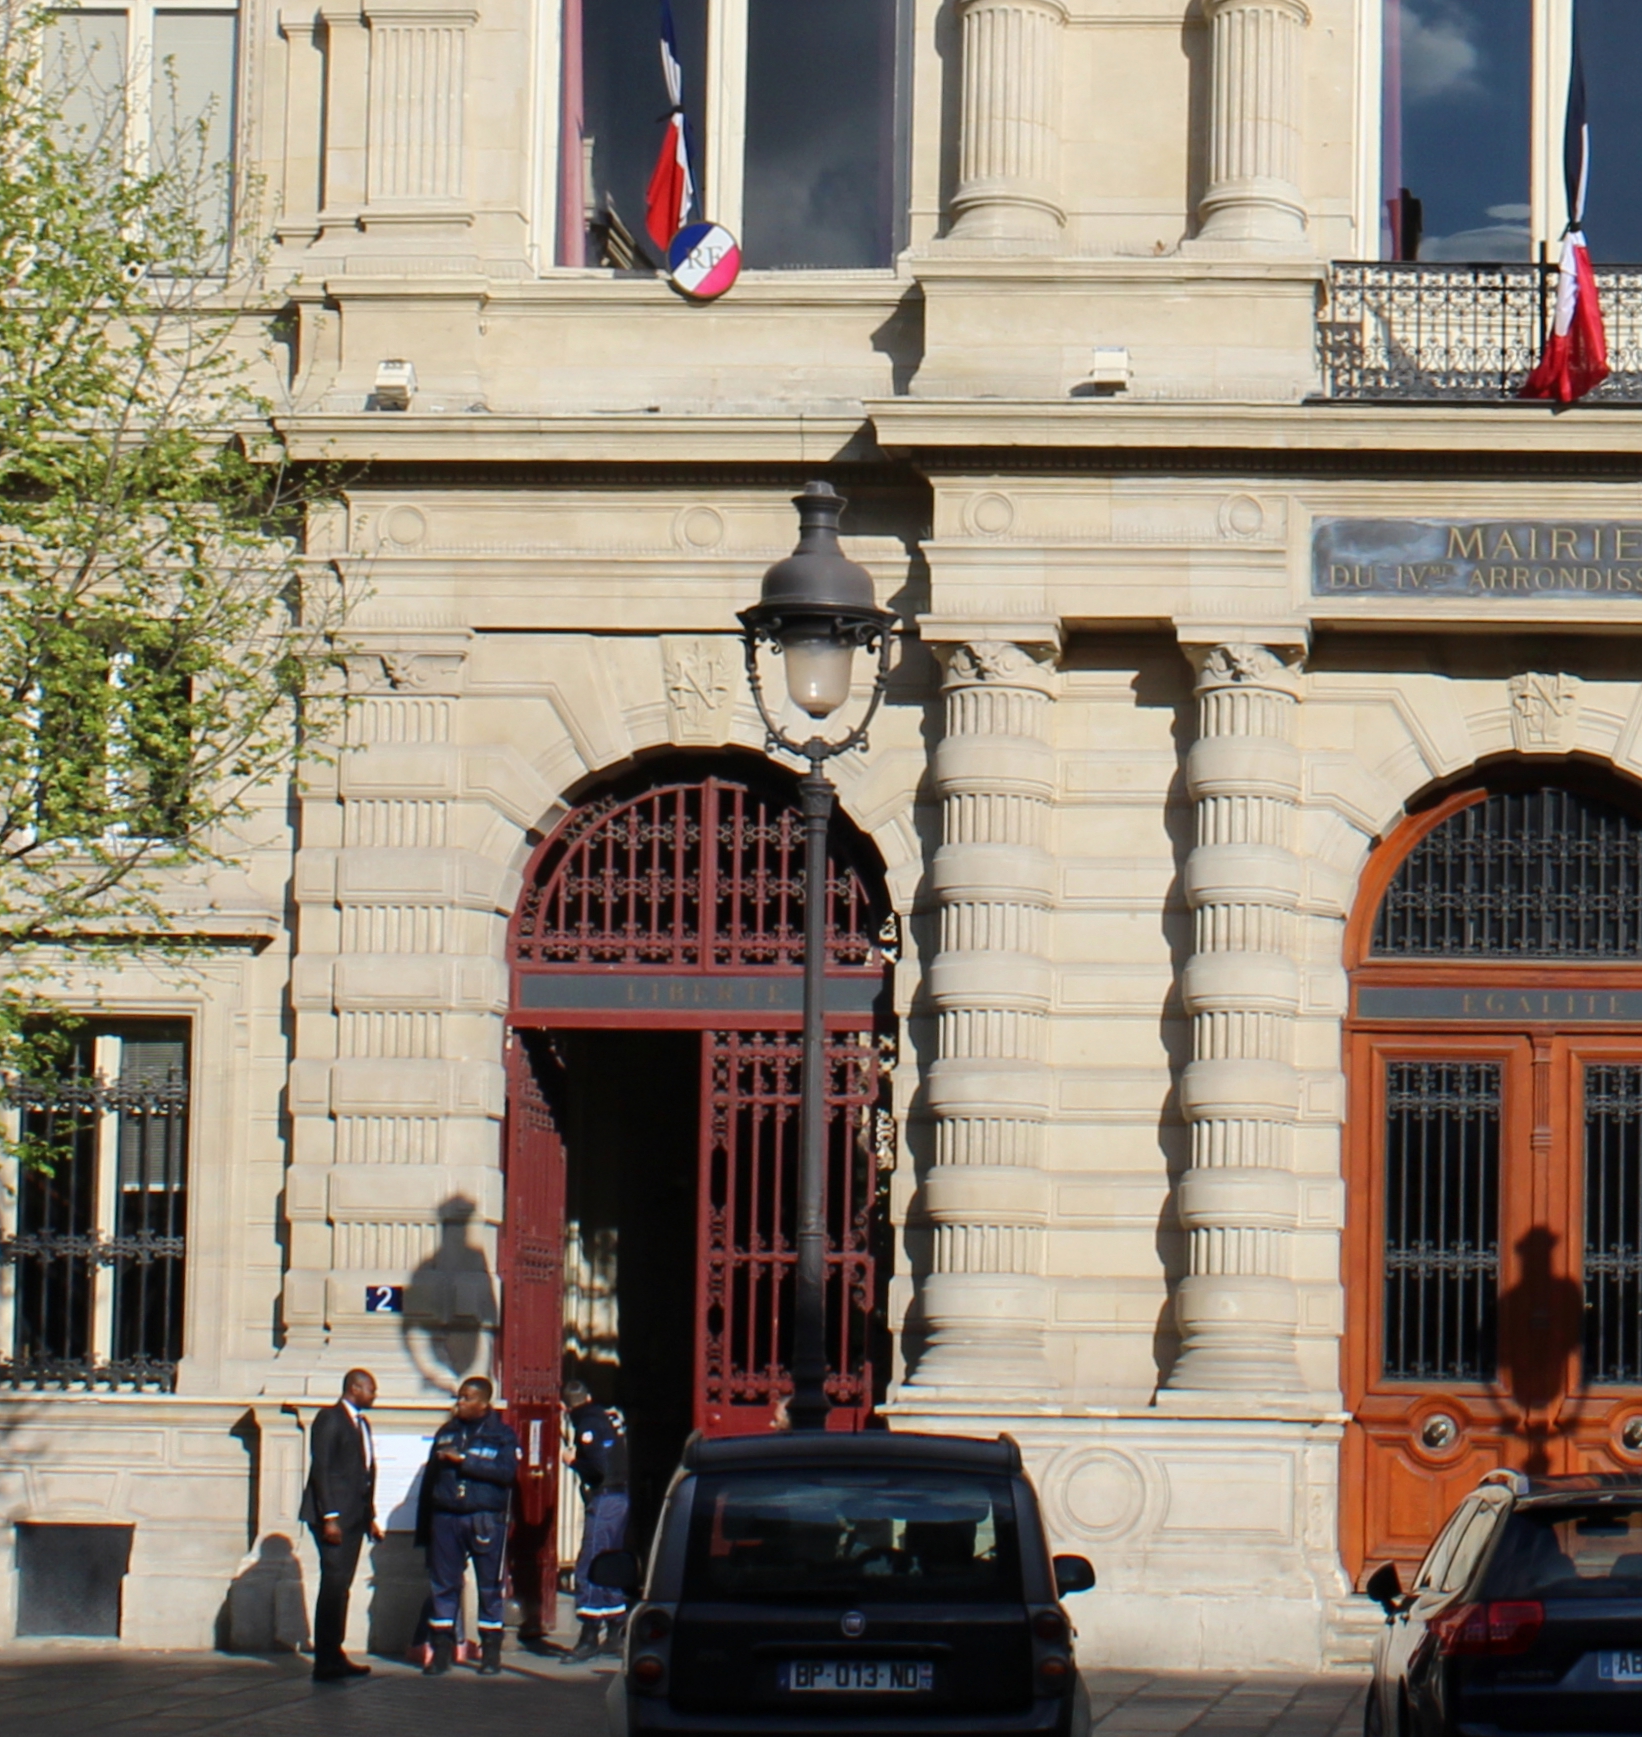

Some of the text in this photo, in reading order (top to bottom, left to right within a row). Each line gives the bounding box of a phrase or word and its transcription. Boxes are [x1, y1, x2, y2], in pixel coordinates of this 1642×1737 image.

[686, 246, 723, 269] RF
[1330, 565, 1374, 589] DU
[1463, 994, 1625, 1014] EGALITE
[376, 1286, 393, 1312] 2
[795, 1663, 918, 1688] BP-013-ND
